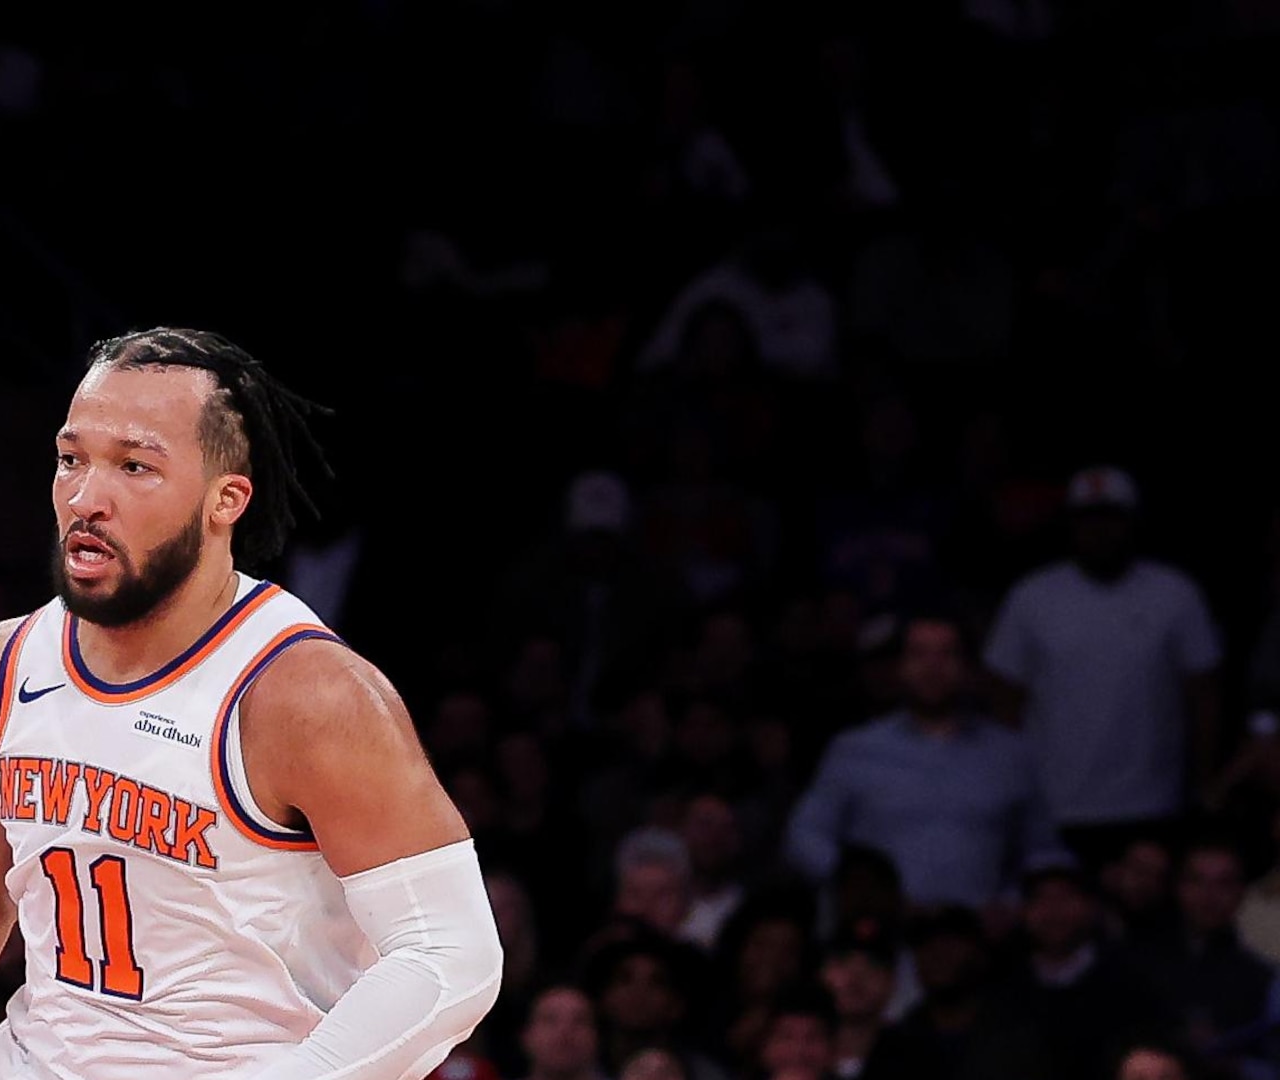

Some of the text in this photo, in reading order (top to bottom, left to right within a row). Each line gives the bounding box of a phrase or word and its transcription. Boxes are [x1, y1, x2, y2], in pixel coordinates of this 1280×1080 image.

[134, 719, 203, 748] abu dhabi
[139, 710, 176, 725] experience
[81, 765, 218, 870] YORK
[40, 846, 144, 1001] 11
